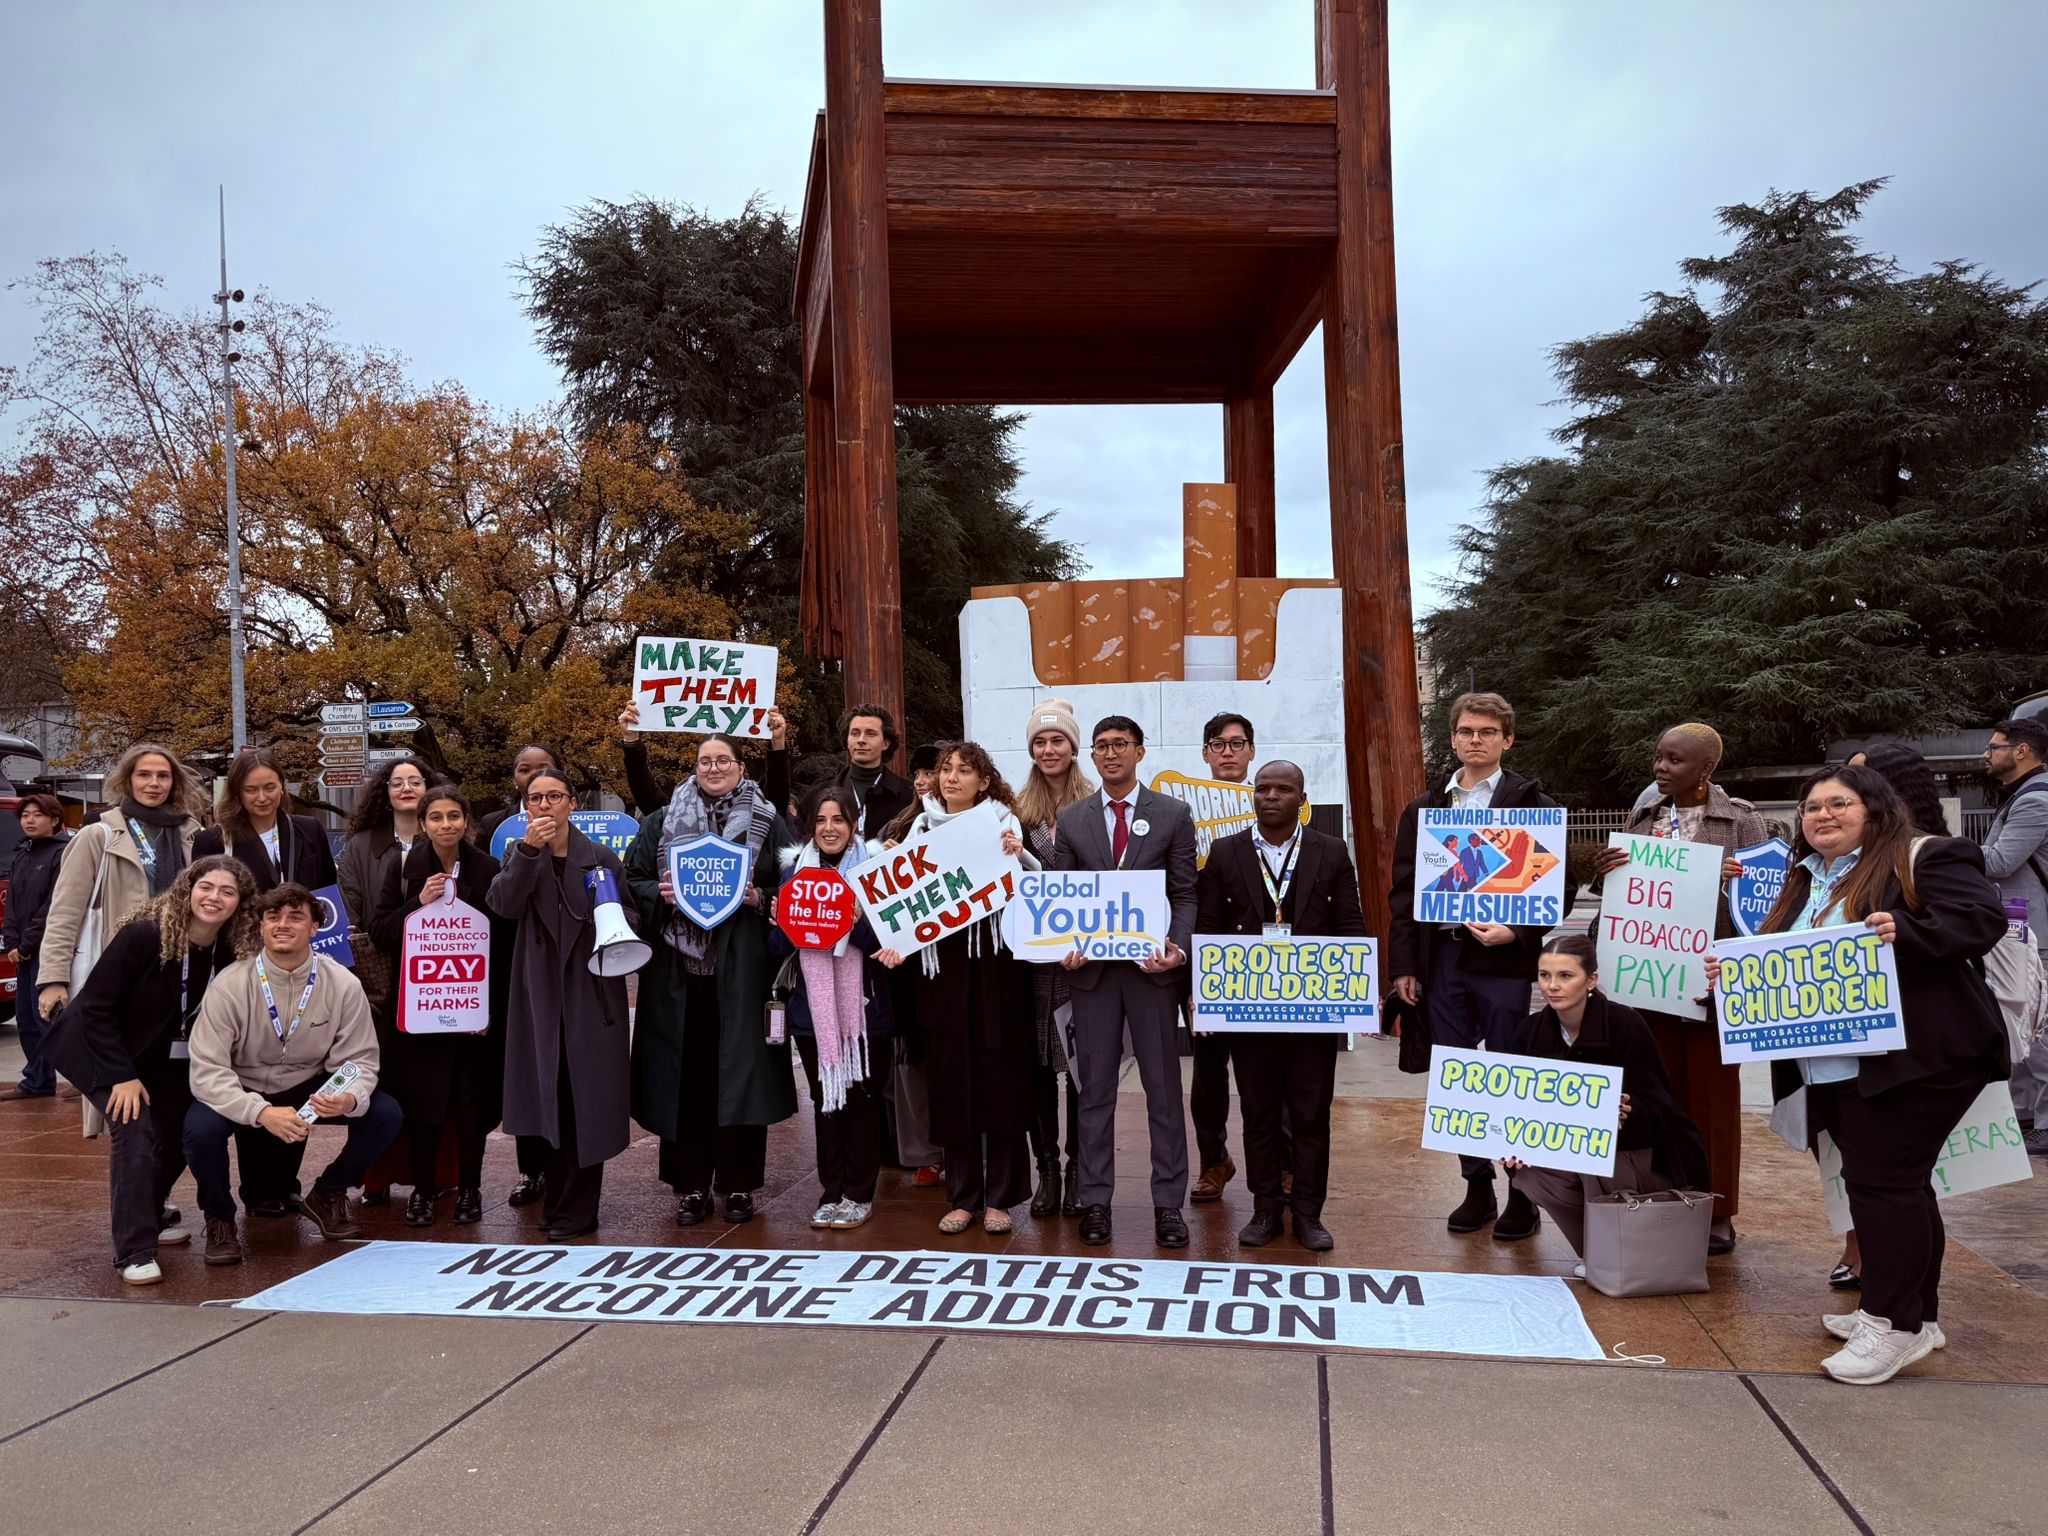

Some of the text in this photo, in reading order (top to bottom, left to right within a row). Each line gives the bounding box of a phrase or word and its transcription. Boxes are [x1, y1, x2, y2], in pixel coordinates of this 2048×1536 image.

[640, 641, 744, 675] MAKE
[639, 676, 757, 705] THEM
[377, 705, 405, 713] Lausanne
[663, 705, 767, 735] PAY!
[1424, 808, 1562, 826] FORWARD-LOOKING
[680, 857, 737, 871] PROTECT
[1424, 855, 1448, 864] Youth
[1629, 839, 1690, 872] MAKE
[694, 871, 724, 883] OUR
[858, 844, 938, 905] KICK
[1019, 873, 1100, 898] Global
[683, 884, 731, 897] FUTURE
[791, 880, 844, 902] STOP
[878, 866, 974, 933] THEM
[1627, 877, 1673, 910] BIG
[1753, 882, 1782, 899] OUR
[789, 903, 842, 921] the lies
[914, 871, 1015, 943] OUT!
[1024, 891, 1146, 936] Youth
[1420, 892, 1559, 925] MEASURES
[1740, 897, 1775, 914] FUTU
[421, 917, 472, 929] MAKE
[1603, 915, 1708, 955] TOBACCO
[311, 933, 344, 950] STRY
[408, 931, 489, 941] THE TOBACCO
[420, 942, 477, 952] INDUSTRY
[1073, 935, 1153, 959] Voices
[417, 958, 480, 981] PAY
[1200, 943, 1372, 974] PROTECT
[1719, 932, 1885, 994] PROTECT
[1200, 972, 1370, 1001] CHILDREN
[1614, 954, 1686, 1001] PAY!
[419, 986, 479, 996] FOR THEIR
[1723, 972, 1888, 1027] CHILDREN
[417, 997, 480, 1011] HARMS
[1240, 1005, 1297, 1013] TOBACCO
[1303, 1006, 1365, 1014] INDUSTRY
[1728, 1017, 1887, 1041] FROM TOBACCO INDUSTRY
[1754, 1032, 1843, 1048] INTERFERENCE
[1440, 1059, 1610, 1109] PROTECT
[1429, 1105, 1612, 1158] THE YOUTH
[438, 1248, 1426, 1306] NO MORE DEATHS FROM
[455, 1280, 1337, 1340] NICOTINE ADDICTION
